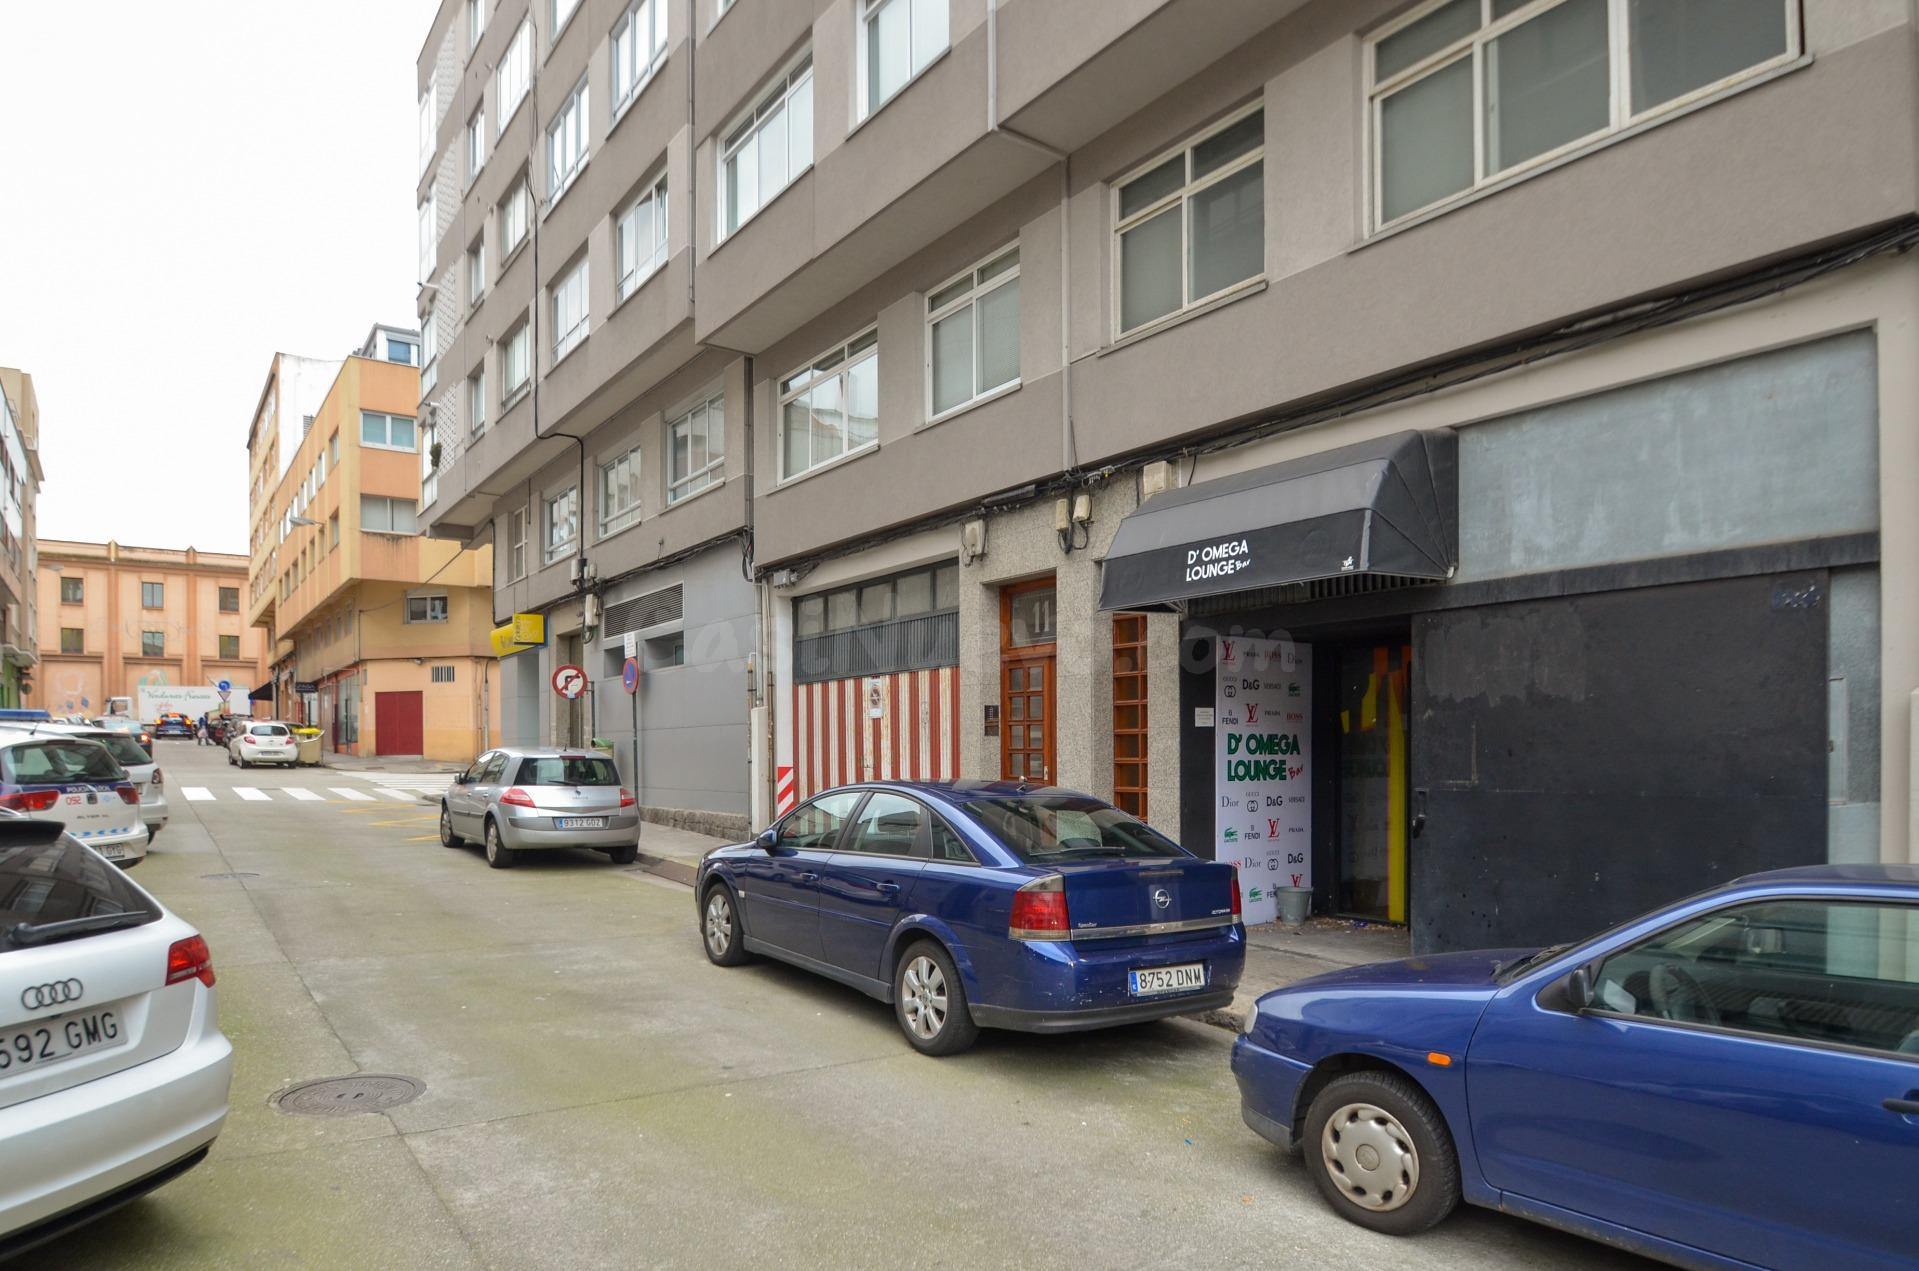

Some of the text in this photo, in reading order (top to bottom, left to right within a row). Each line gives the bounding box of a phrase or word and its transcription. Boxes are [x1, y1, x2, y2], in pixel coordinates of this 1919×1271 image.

[1187, 539, 1248, 565] D' OMEGA
[1185, 558, 1251, 582] LOUNGE Bar
[1032, 600, 1050, 633] 11
[1242, 679, 1260, 690] D&G
[1222, 717, 1239, 725] FENDI
[1227, 733, 1300, 756] D' OMEGA
[1227, 759, 1287, 782] LOUNGE
[1221, 795, 1239, 808] Dior
[1266, 795, 1283, 807] D&G
[1244, 832, 1261, 840] FENDI
[1244, 857, 1262, 869] Dior
[1287, 853, 1304, 864] D&G
[1138, 967, 1202, 990] 8752 DNM
[64, 1011, 118, 1049] GMG
